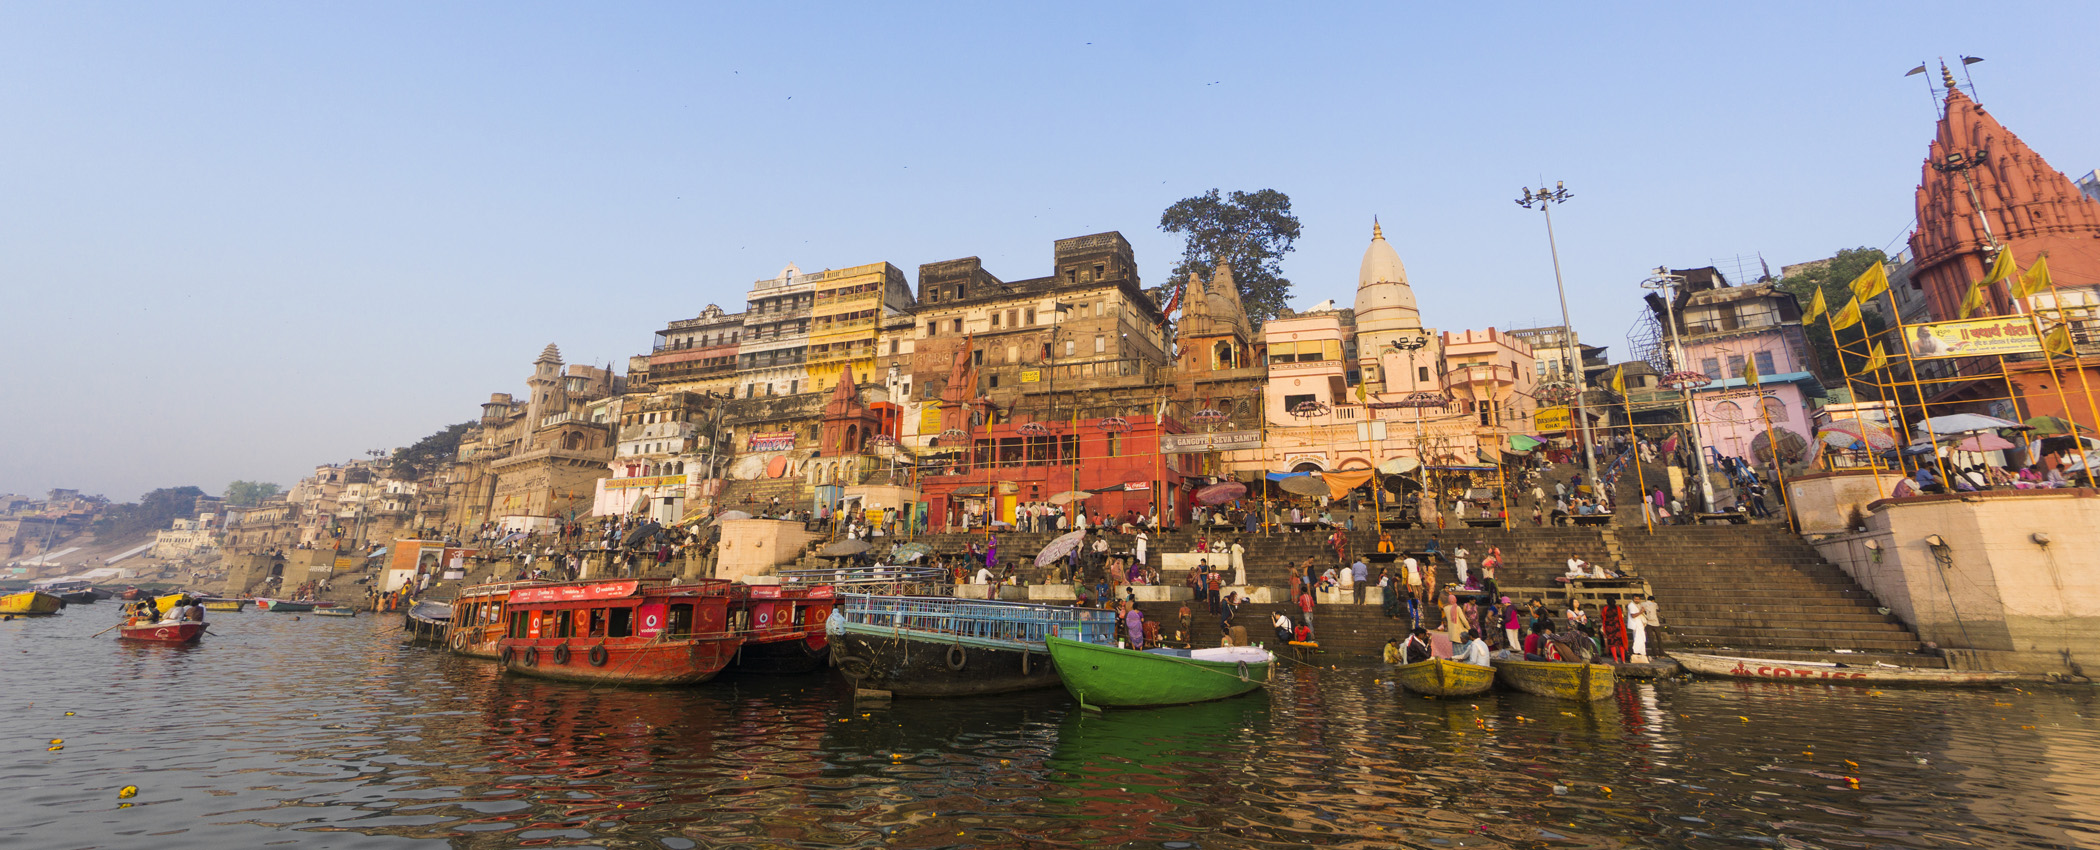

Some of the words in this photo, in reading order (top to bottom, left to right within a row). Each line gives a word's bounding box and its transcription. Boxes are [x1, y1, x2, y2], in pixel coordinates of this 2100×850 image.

[1970, 323, 2002, 338] यथार्थ
[2003, 322, 2029, 337] गीता
[1177, 437, 1211, 446] GANGOTR
[1213, 436, 1232, 444] SEVA
[1233, 433, 1260, 443] SAMITI
[631, 478, 642, 486] SILK
[642, 477, 665, 486] FACTOY
